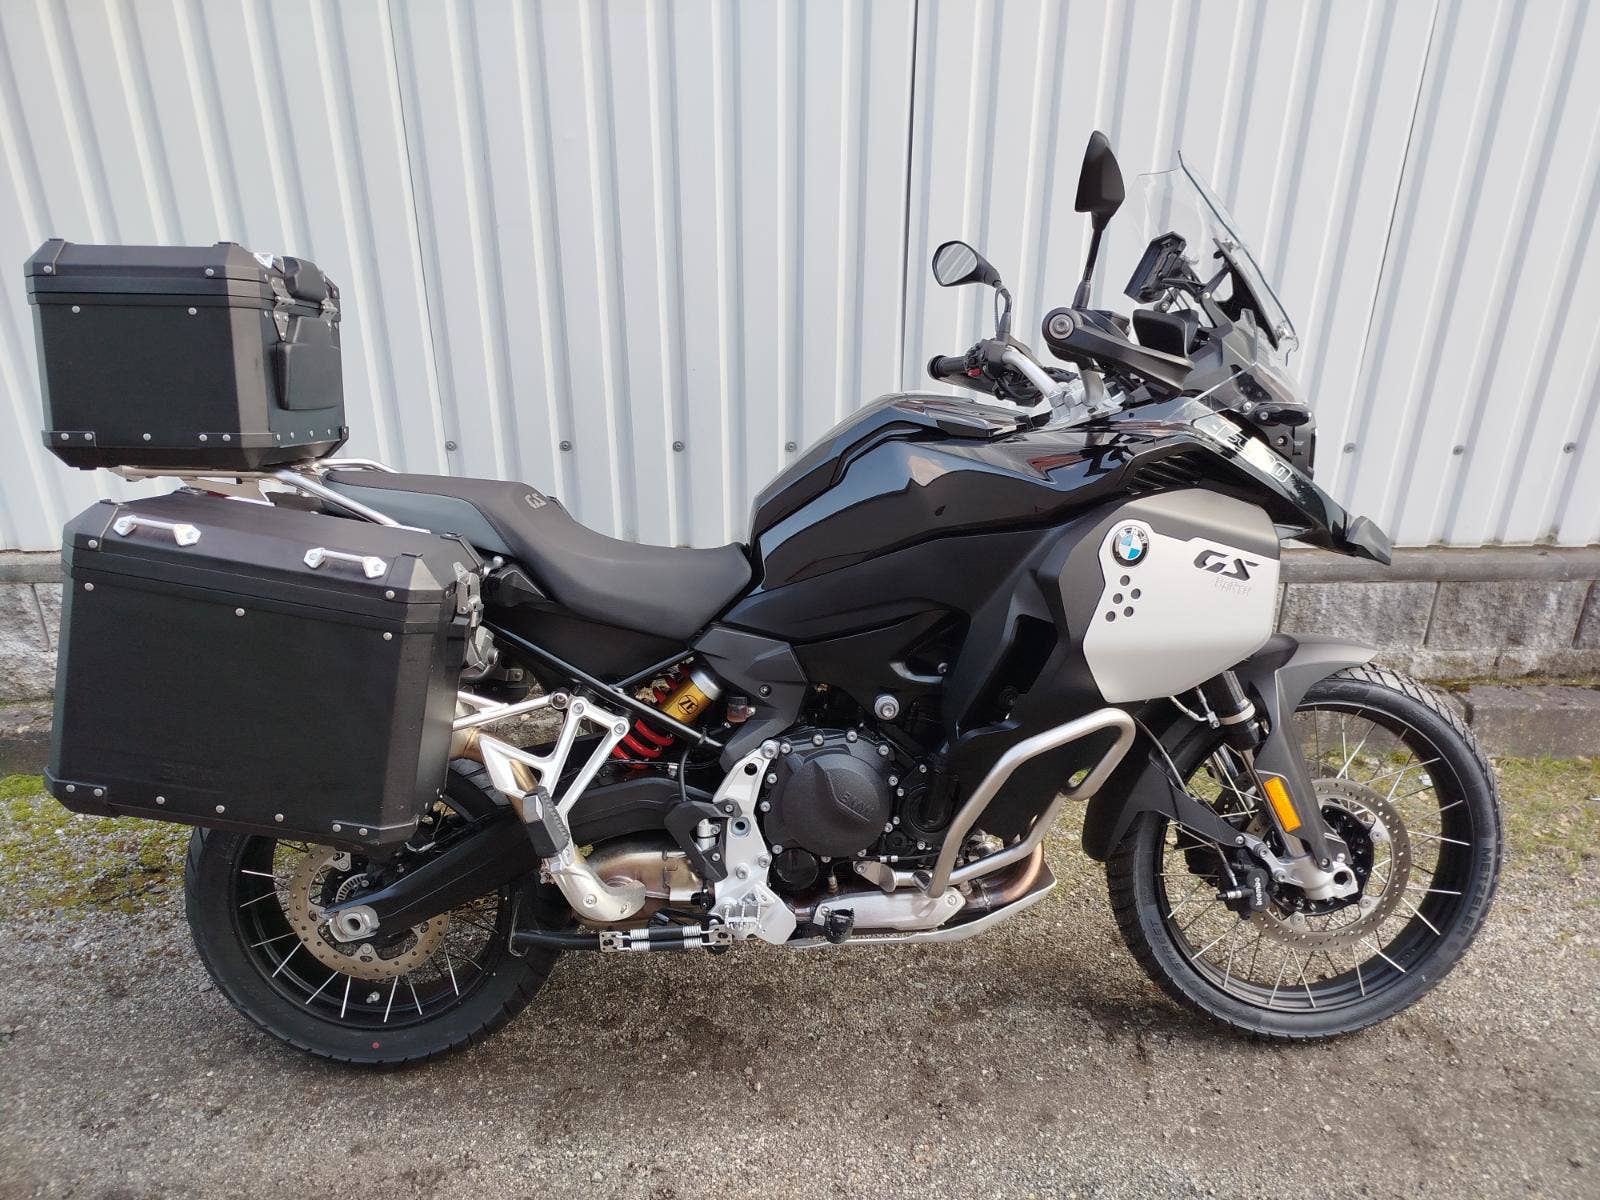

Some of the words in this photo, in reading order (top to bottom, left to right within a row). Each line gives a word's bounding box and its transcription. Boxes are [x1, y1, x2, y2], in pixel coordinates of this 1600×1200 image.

[1193, 549, 1260, 581] GS
[1254, 877, 1263, 906] brembo
[1454, 846, 1495, 936] METZELER
[1147, 918, 1185, 972] STREET
